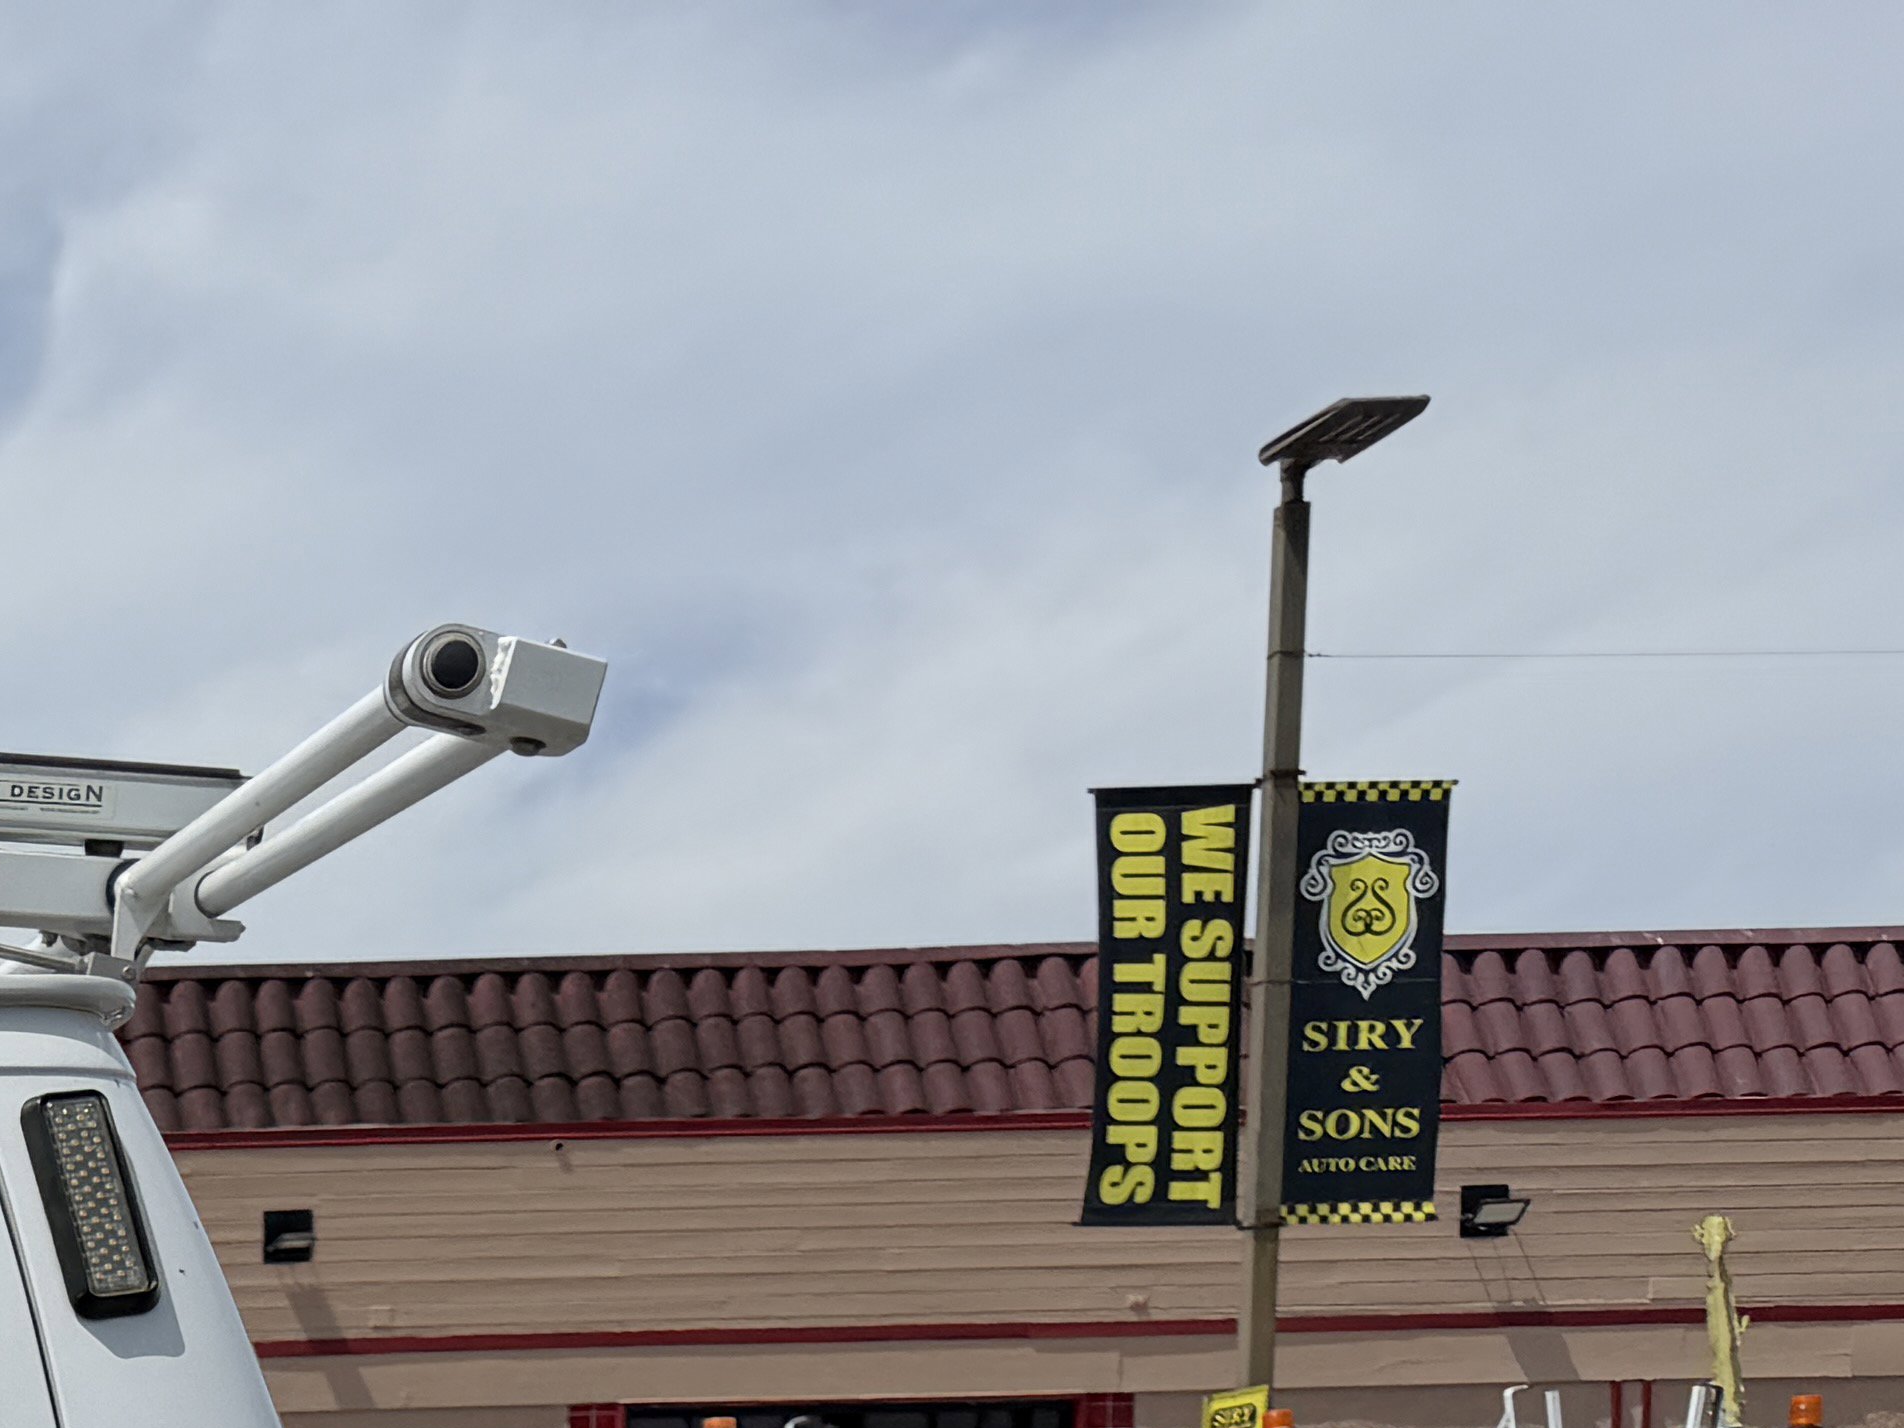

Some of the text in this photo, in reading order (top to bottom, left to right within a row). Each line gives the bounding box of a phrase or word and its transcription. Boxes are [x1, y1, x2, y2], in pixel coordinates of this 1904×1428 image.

[9, 784, 104, 803] DESIGN
[1098, 812, 1167, 1206] OUR TROOPS
[1167, 804, 1238, 1209] WE SUPPORT
[1302, 1019, 1424, 1052] SIRY
[1341, 1066, 1381, 1093] &
[1297, 1107, 1422, 1142] SONS
[1298, 1155, 1417, 1173] AUTO CARE
